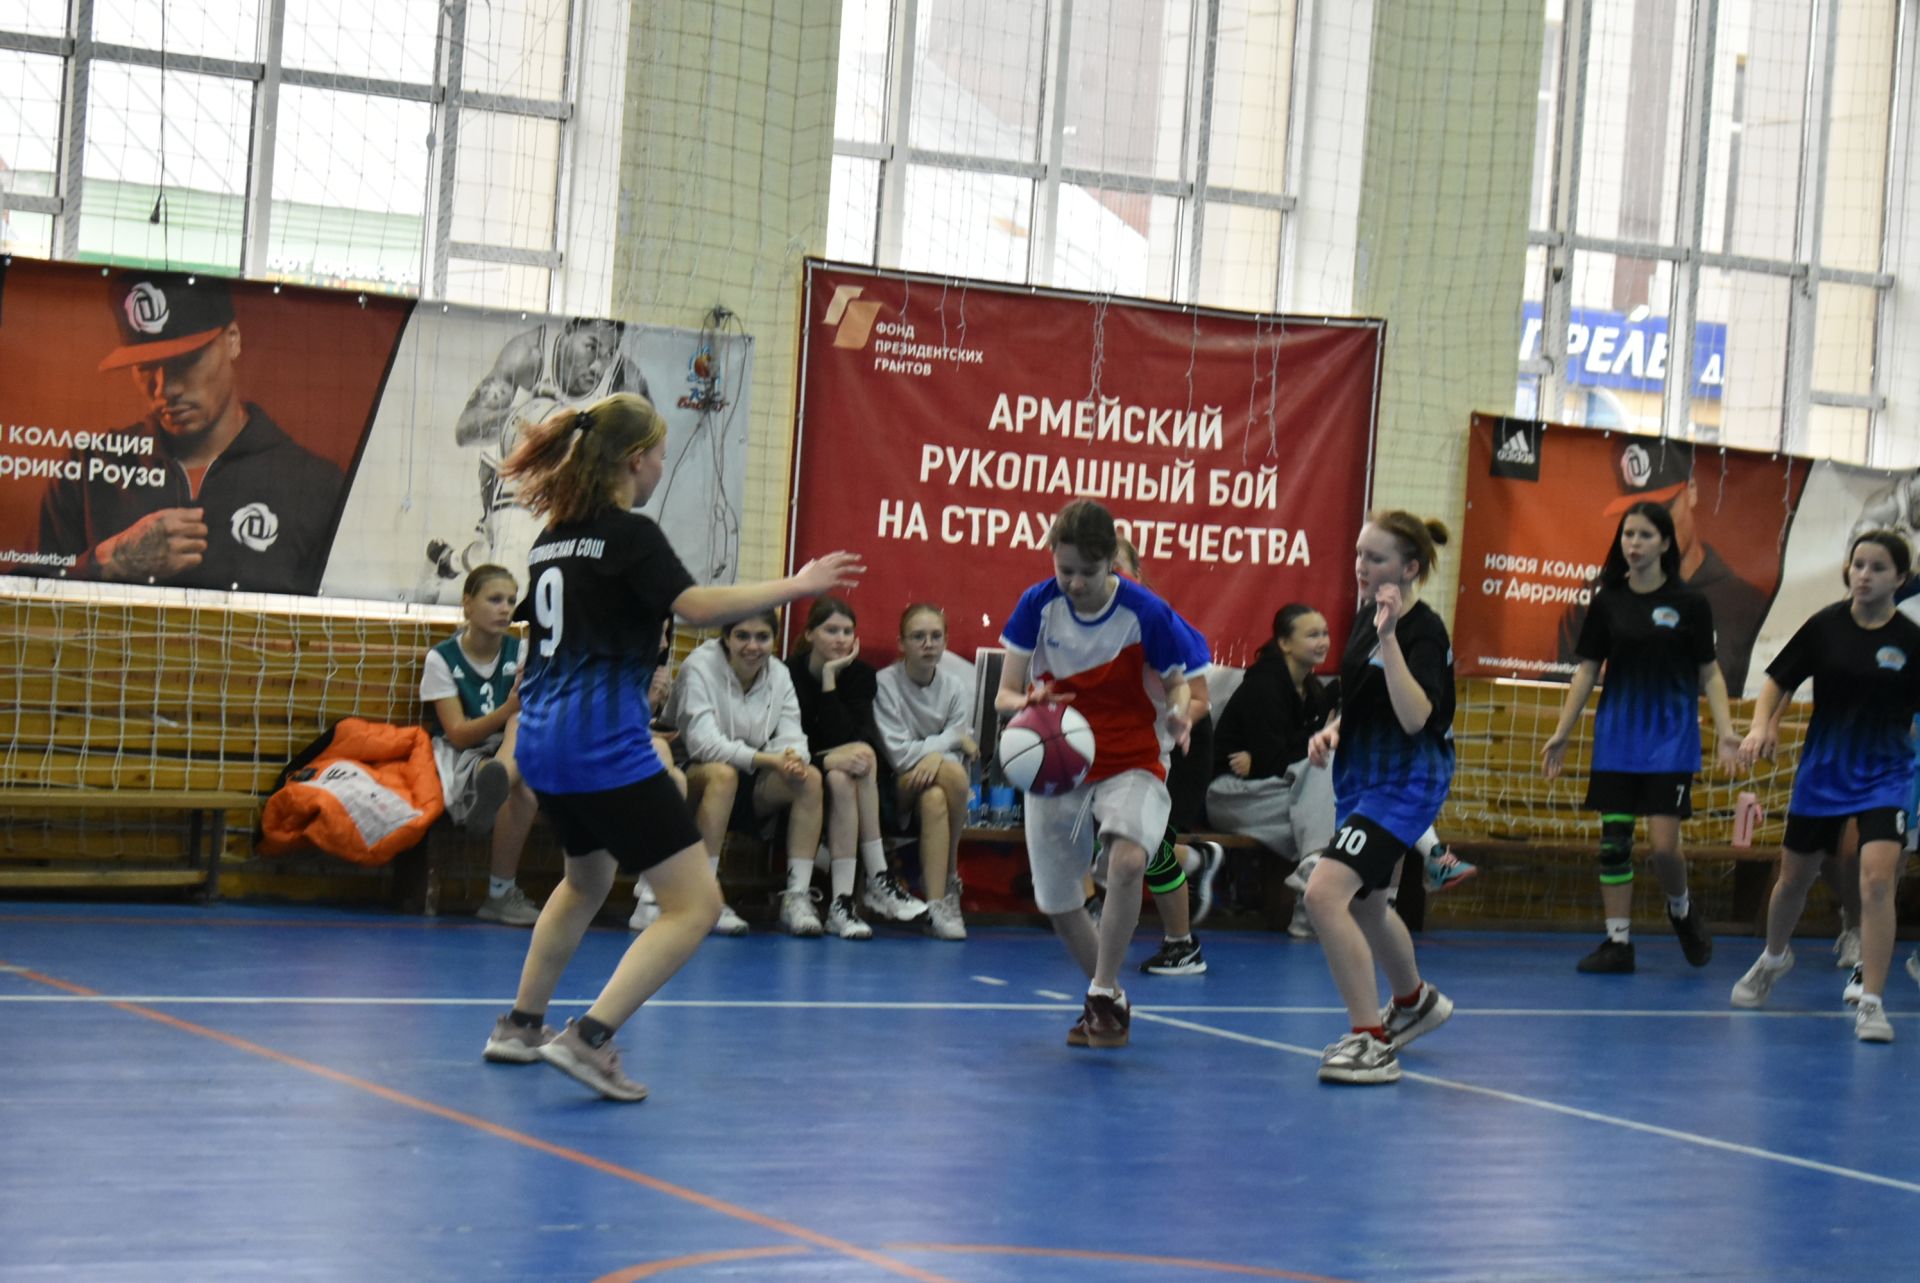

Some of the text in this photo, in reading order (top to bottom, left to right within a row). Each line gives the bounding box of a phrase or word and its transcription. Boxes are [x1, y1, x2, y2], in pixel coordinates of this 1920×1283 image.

[876, 321, 915, 340] ФОНД
[875, 339, 984, 363] ПРЕЗИДЕНТСКИХ
[874, 357, 932, 376] ГРАНТОВ
[988, 393, 1223, 450] АРМЕЙСКИЙ
[9, 425, 153, 456] коллекция
[88, 458, 166, 489] Роуза
[919, 444, 1278, 510] РУКОПАШНЫЙ БОЙ
[877, 499, 929, 541] НА
[1485, 553, 1538, 574] новая
[1482, 577, 1591, 606] от Деррика
[535, 566, 564, 657] 9
[480, 681, 495, 715] 3
[1676, 784, 1685, 807] 7
[1335, 826, 1368, 856] 10
